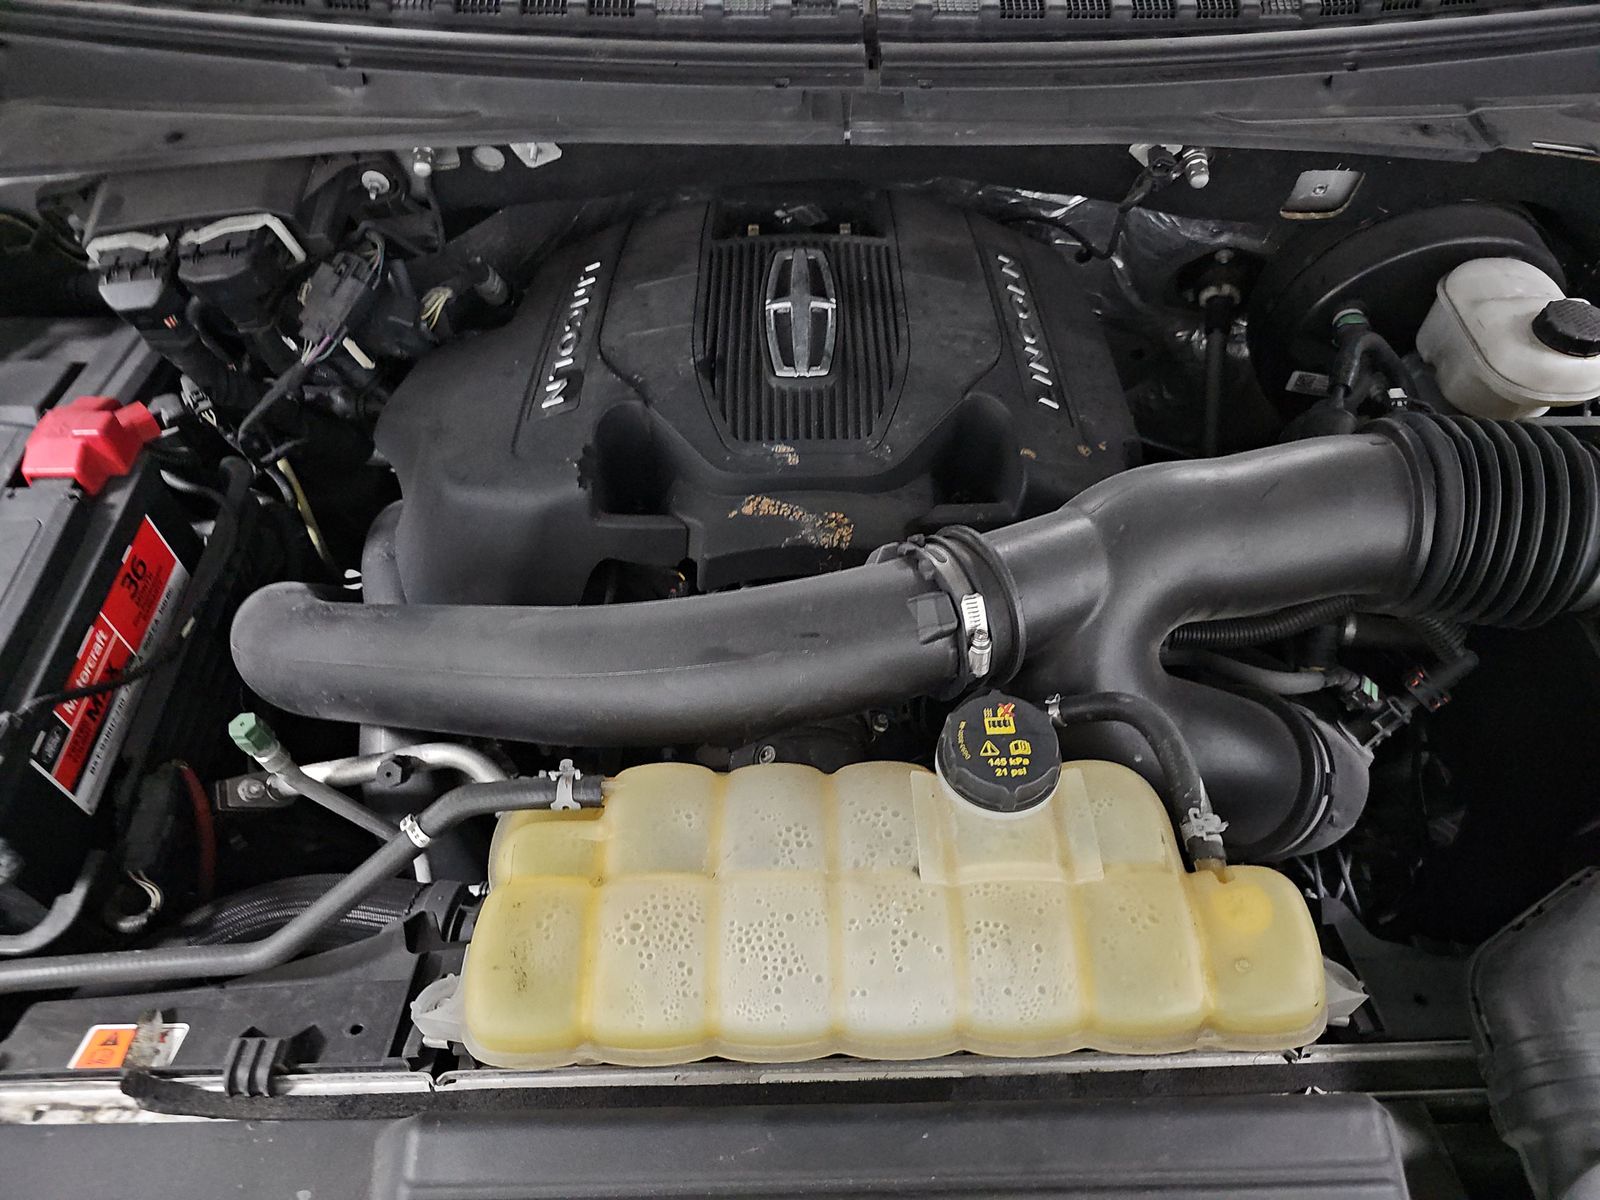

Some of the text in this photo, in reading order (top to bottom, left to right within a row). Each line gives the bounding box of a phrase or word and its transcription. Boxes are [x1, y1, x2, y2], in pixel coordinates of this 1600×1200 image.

[542, 262, 600, 409] LINCOLN
[998, 255, 1059, 409] LINCOLN
[121, 556, 147, 594] 36
[63, 627, 108, 715] Mtorcraft
[988, 757, 1029, 766] 145 kPa
[995, 767, 1026, 777] 21 psi
